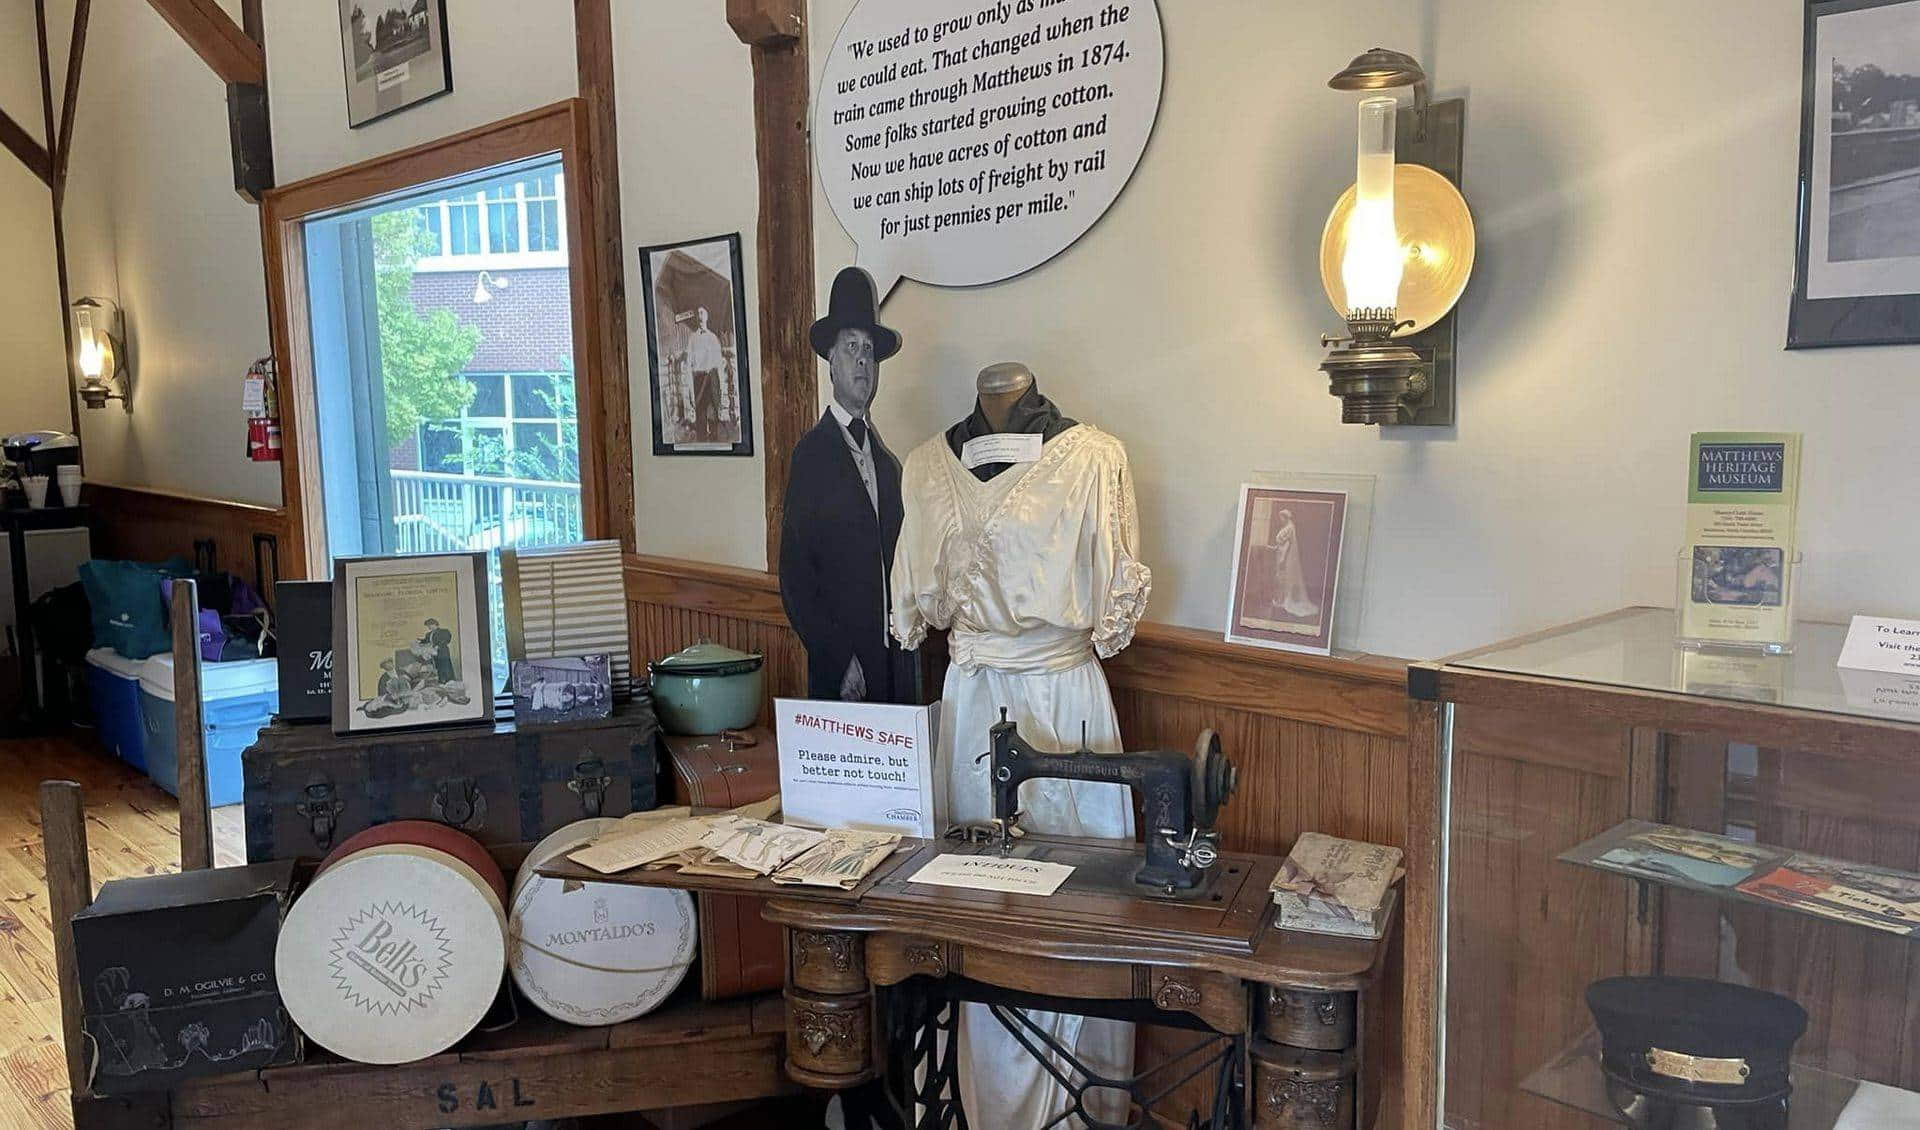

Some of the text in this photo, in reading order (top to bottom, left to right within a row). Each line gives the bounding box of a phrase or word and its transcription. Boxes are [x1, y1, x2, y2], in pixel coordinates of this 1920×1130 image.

[878, 28, 910, 53] used
[914, 27, 928, 44] to
[933, 15, 972, 42] grow
[976, 1, 1011, 25] only
[1016, 0, 1034, 15] as
[837, 4, 1130, 94] we could eat. That changed when the
[833, 40, 1130, 126] train came through Matthews in 1874.
[845, 83, 1114, 152] Some folks started growing cotton.
[850, 114, 1107, 182] Now we have acres of cotton and
[853, 149, 1106, 210] we can ship lots of freight by rail
[880, 190, 1076, 240] for just pennies per mile."
[1701, 450, 1783, 462] MATTHEWS
[1706, 462, 1777, 474] HERITAGE
[1709, 473, 1772, 484] MUSEUM
[1876, 625, 1890, 633] To
[1878, 640, 1900, 650] Visit
[795, 713, 914, 749] #MATTHEWS SAFE
[798, 750, 836, 762] Please
[888, 756, 909, 767] but
[801, 764, 906, 782] better not touch!
[962, 860, 1042, 874] ANTIQUES
[546, 922, 656, 947] MONTALDO'S
[194, 976, 234, 992] OGILVIE
